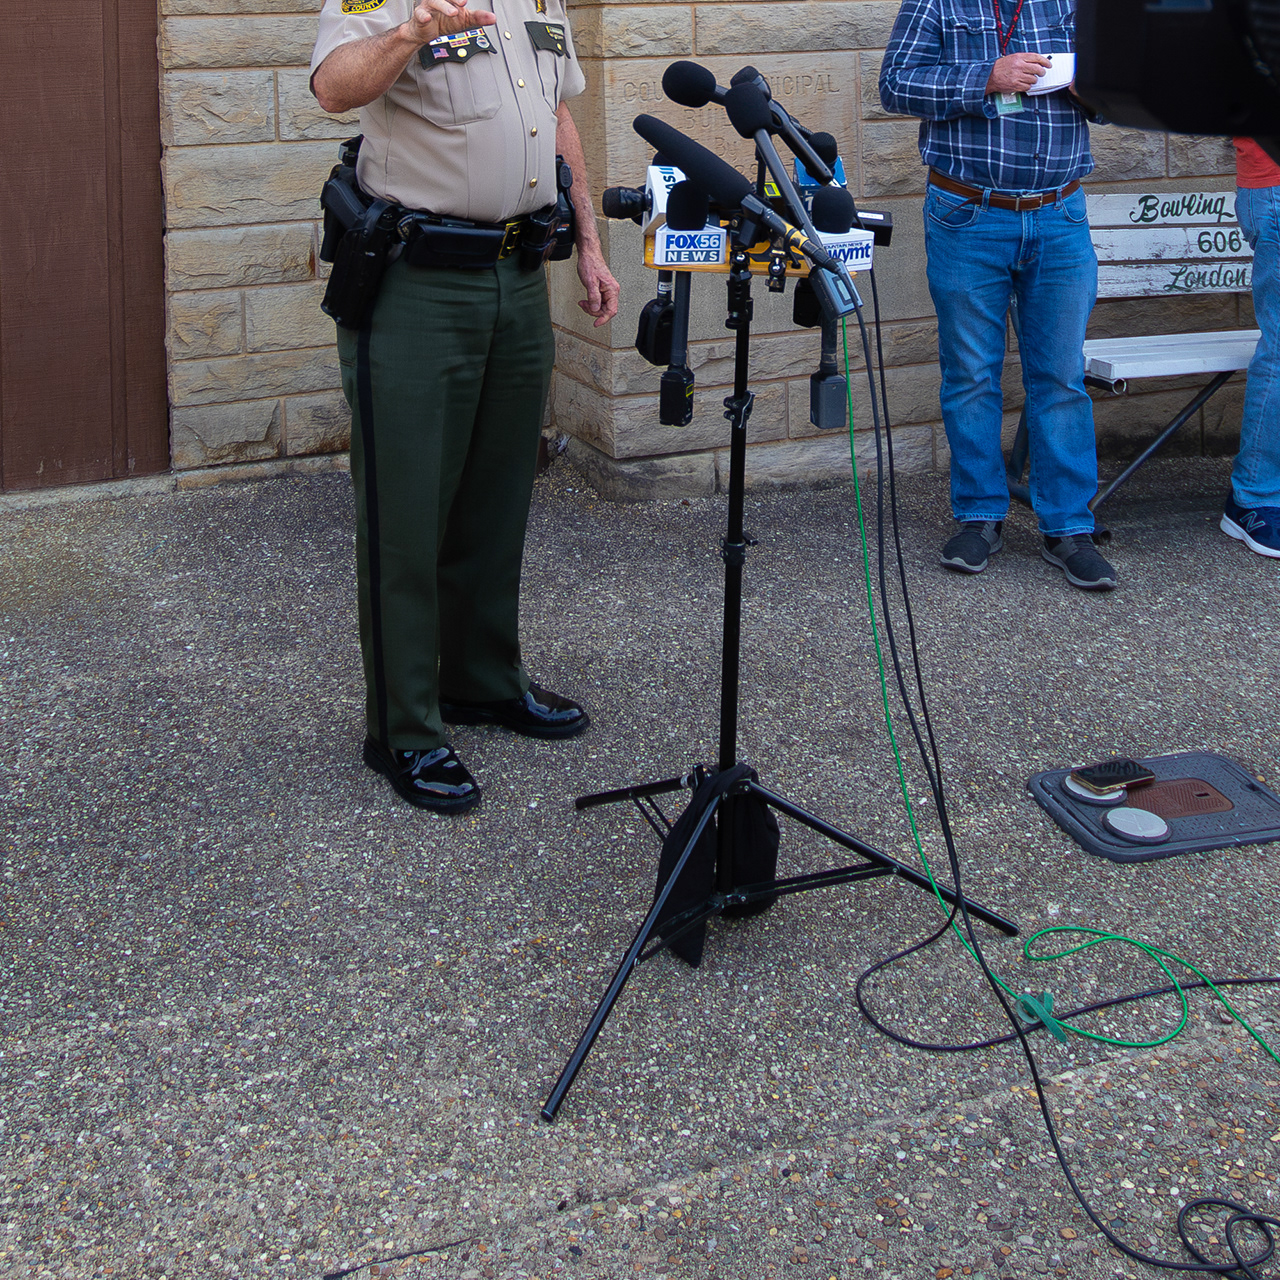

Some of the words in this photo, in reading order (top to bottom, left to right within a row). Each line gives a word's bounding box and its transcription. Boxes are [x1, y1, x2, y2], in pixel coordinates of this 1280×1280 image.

[351, 0, 379, 11] COUNTY
[1129, 194, 1235, 222] Bowling
[667, 251, 718, 262] NEWS
[1163, 264, 1250, 293] London
